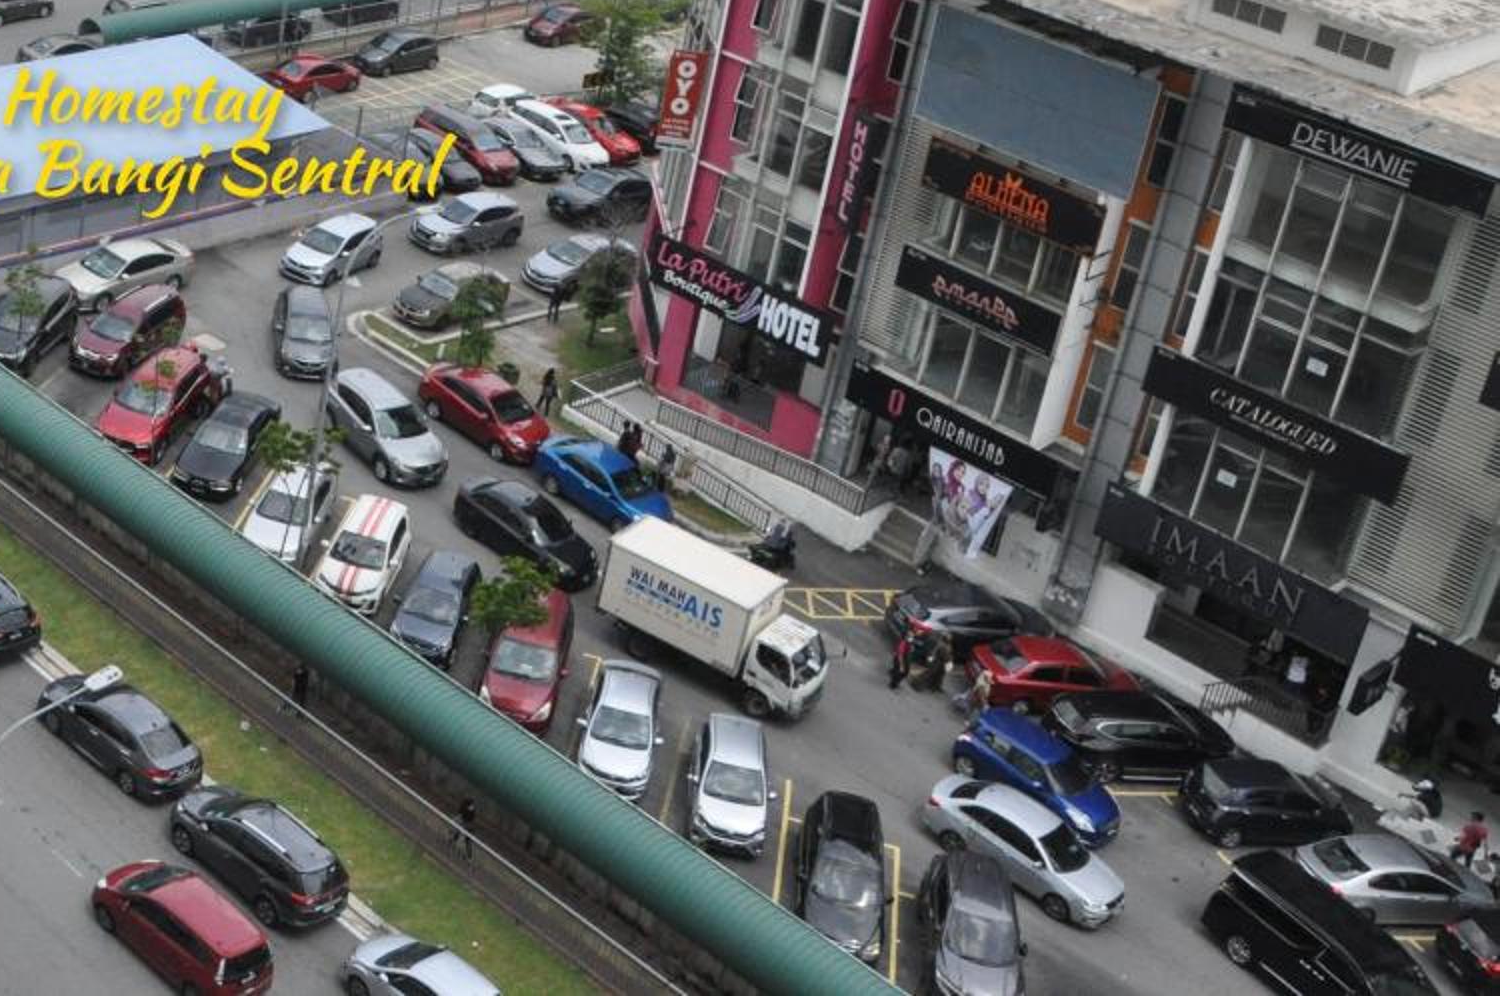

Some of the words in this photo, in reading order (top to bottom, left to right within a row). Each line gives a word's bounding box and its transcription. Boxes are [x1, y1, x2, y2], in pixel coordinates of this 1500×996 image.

[670, 60, 698, 115] OYO
[837, 120, 868, 222] HOTEL
[1291, 122, 1419, 183] DEWANIE
[658, 240, 688, 272] La
[689, 258, 746, 303] Putri
[663, 268, 732, 309] Boutique
[757, 293, 822, 357] HOTEL
[1210, 387, 1339, 455] CATALOGUED
[1151, 516, 1306, 614] IMAAN
[684, 594, 724, 629] AIS
